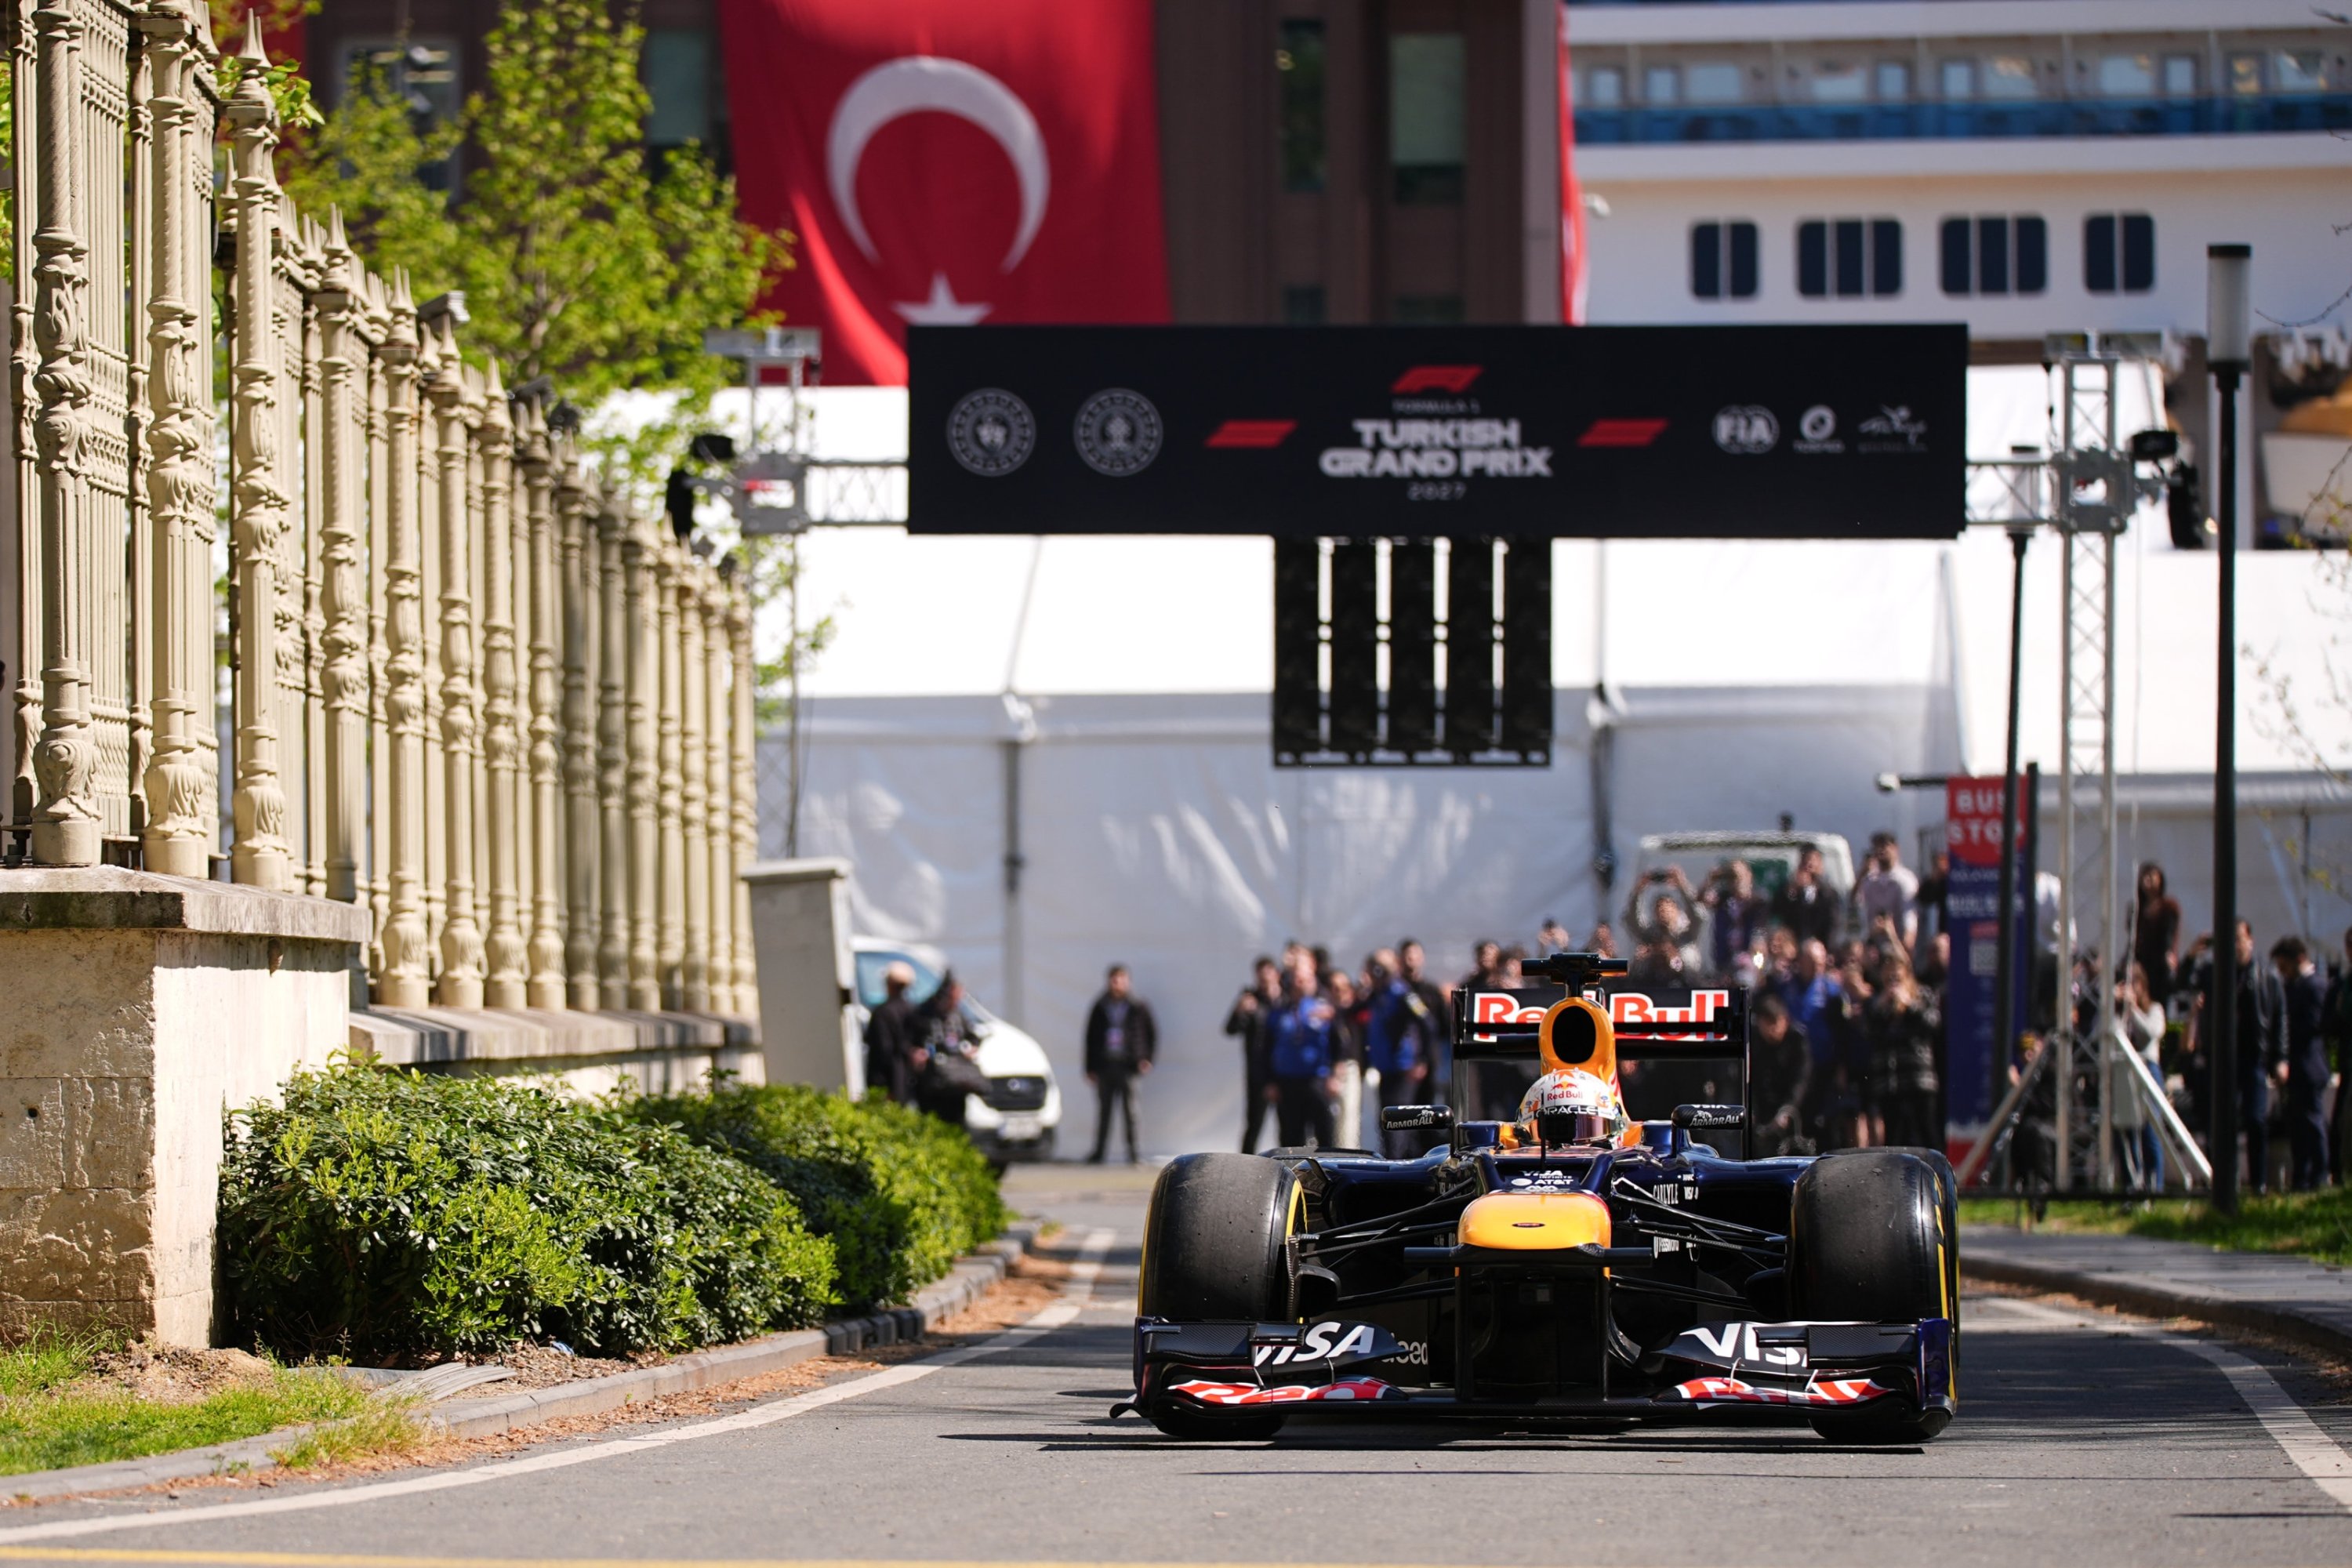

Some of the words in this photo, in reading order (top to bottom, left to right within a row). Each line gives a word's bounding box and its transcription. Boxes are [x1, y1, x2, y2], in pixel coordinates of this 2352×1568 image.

[1352, 418, 1521, 448] TURKISH
[1716, 414, 1773, 445] FIA
[1319, 447, 1457, 477] GRAND
[1461, 446, 1554, 477] PRIX
[1407, 481, 1467, 500] 2027
[1610, 989, 1729, 1042] Bull
[1537, 1105, 1596, 1116] ORACLE
[1548, 1091, 1564, 1101] Red
[1566, 1091, 1583, 1099] Bull
